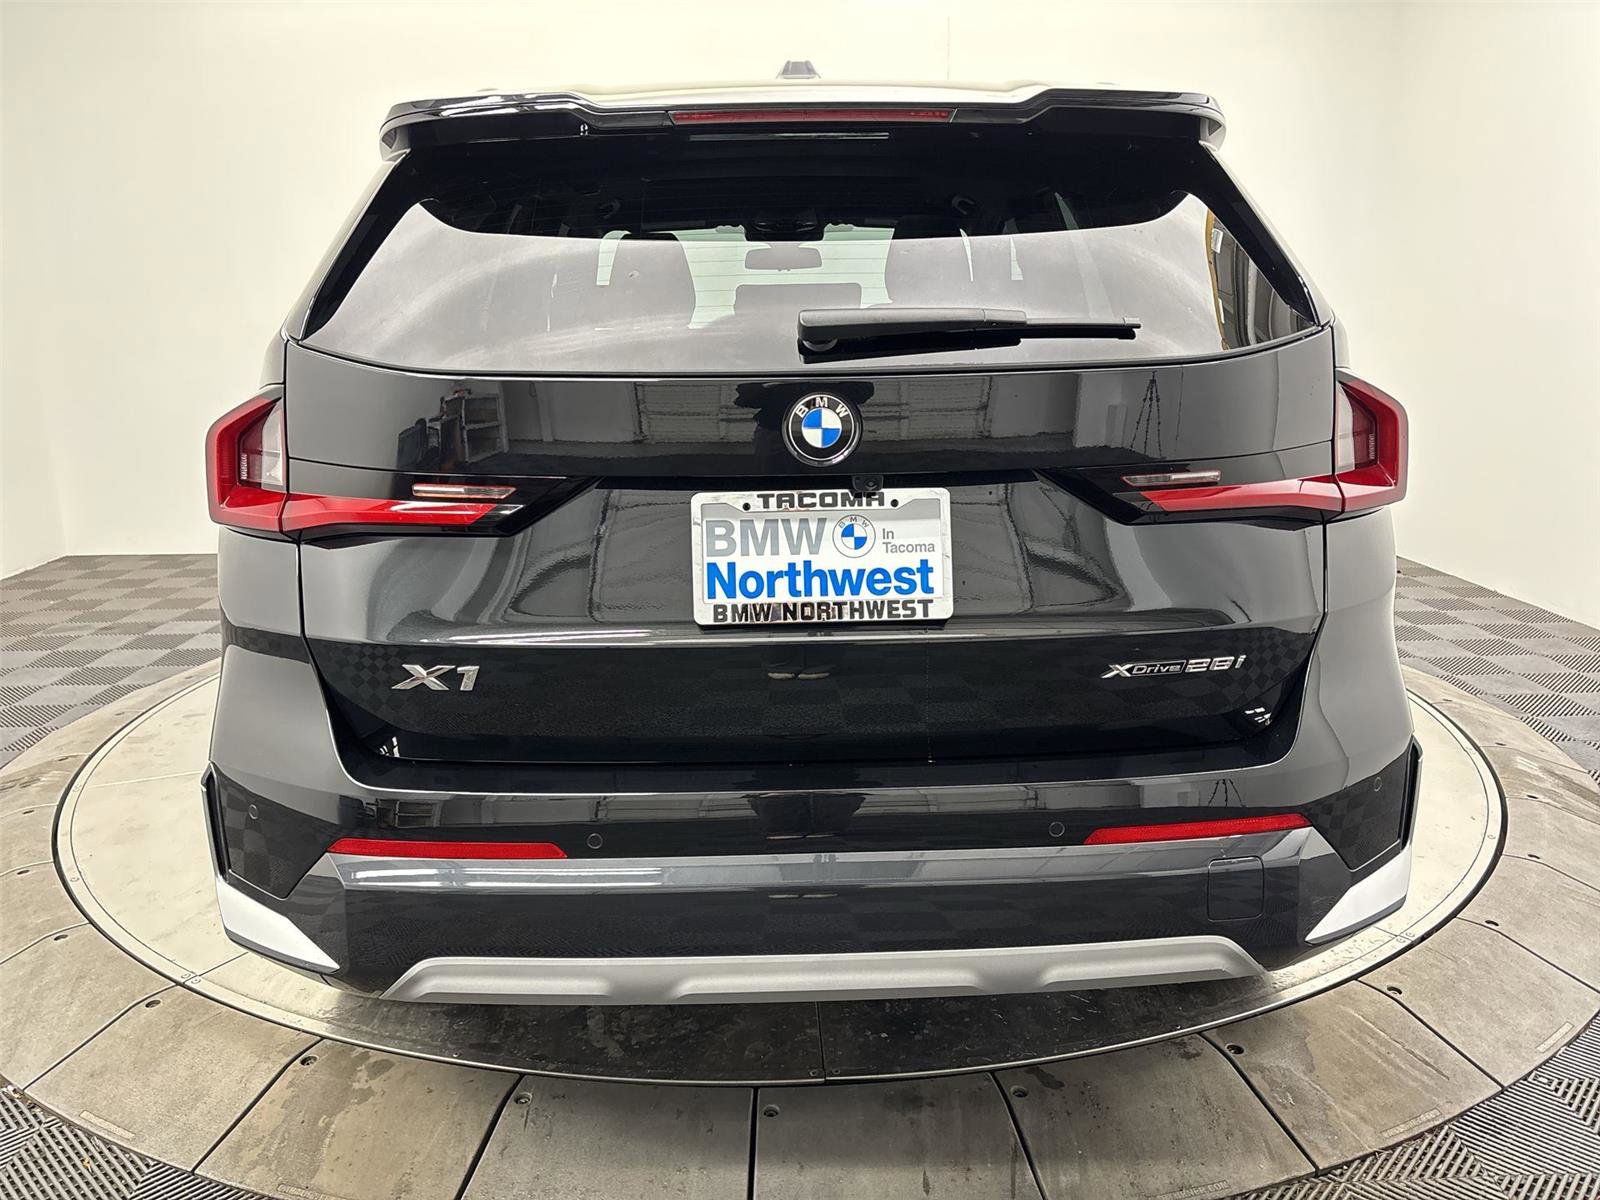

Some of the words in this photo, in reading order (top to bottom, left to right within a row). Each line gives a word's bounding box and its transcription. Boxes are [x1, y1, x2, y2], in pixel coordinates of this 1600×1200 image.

[795, 397, 849, 418] BMW
[757, 492, 885, 509] TACOMA
[838, 516, 869, 529] BMW
[705, 517, 827, 557] BMW
[882, 528, 894, 540] In
[882, 541, 935, 555] Tacoma
[706, 559, 934, 600] Northwest
[713, 603, 771, 623] BMW
[783, 599, 934, 622] NORTHWEST
[391, 664, 480, 691] X1
